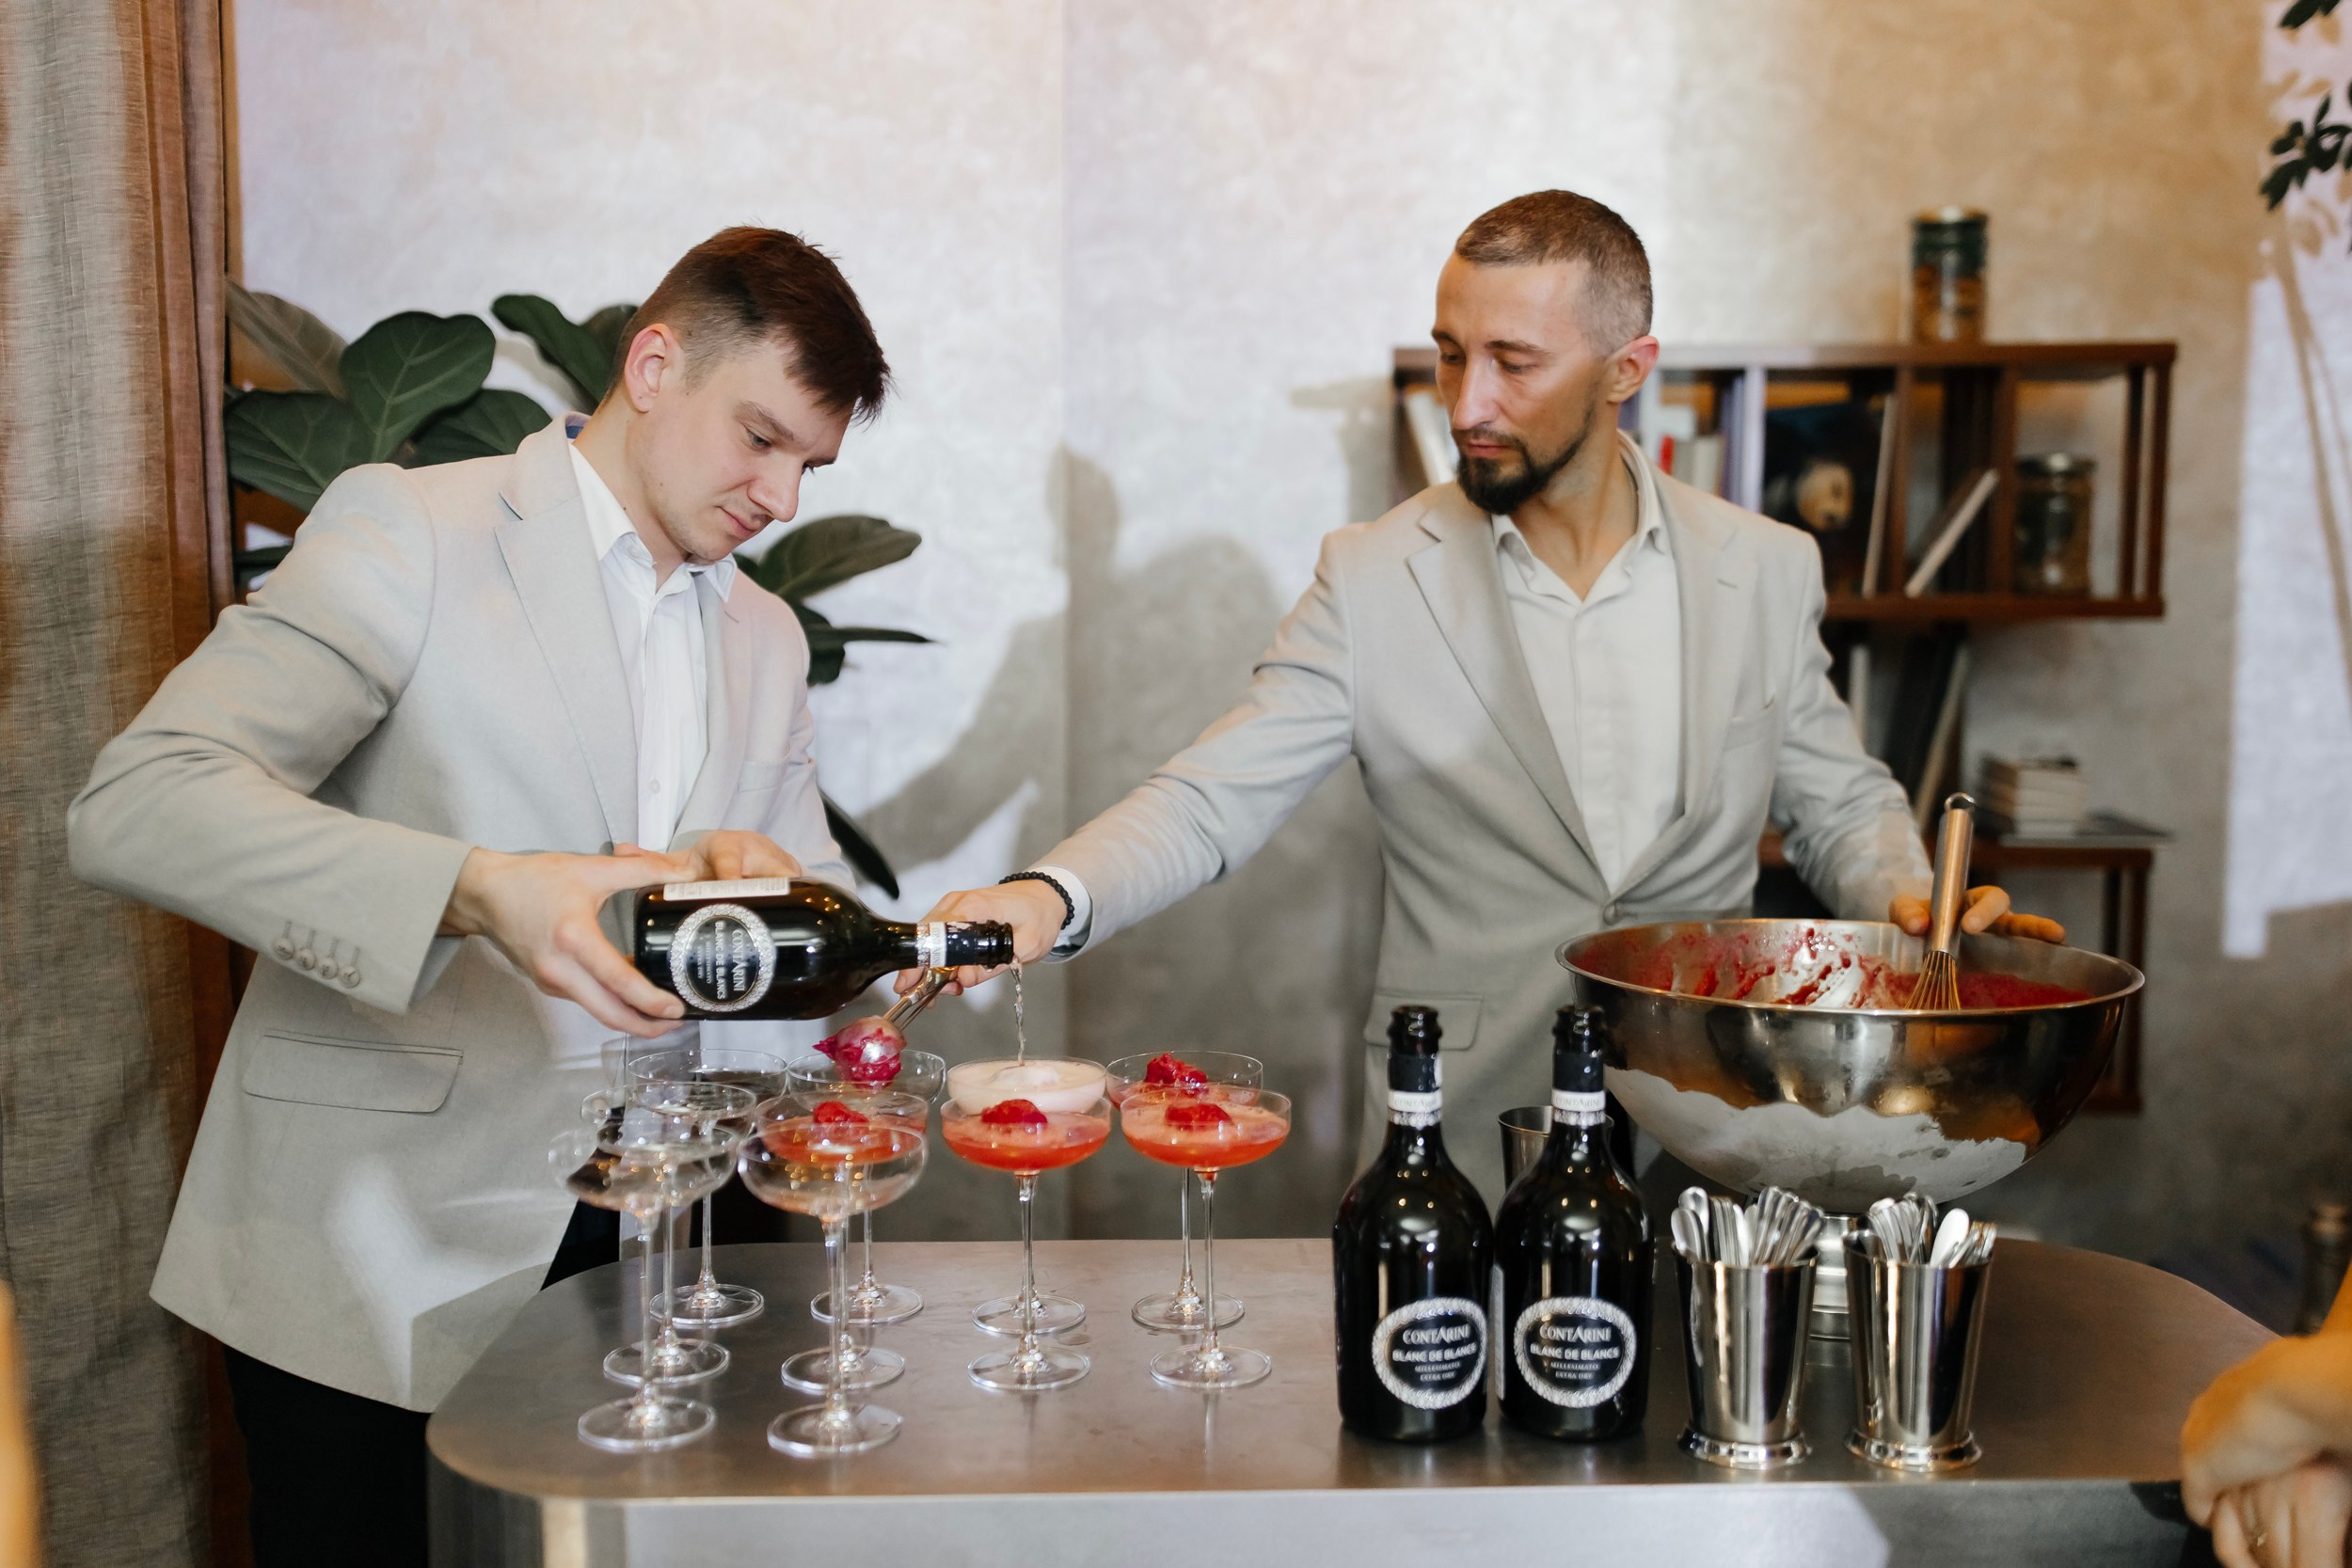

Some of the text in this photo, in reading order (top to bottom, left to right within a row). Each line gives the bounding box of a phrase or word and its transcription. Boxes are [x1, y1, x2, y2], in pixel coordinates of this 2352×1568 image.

[715, 921, 726, 999] BLANC DE BLANCS
[731, 928, 749, 991] CONTARINI
[1402, 1324, 1471, 1345] CONTARINI
[1539, 1323, 1612, 1344] CONTARINI
[1392, 1342, 1477, 1362] BLANC DE BLANCS
[1530, 1343, 1620, 1361] BLANC DE BLANCS
